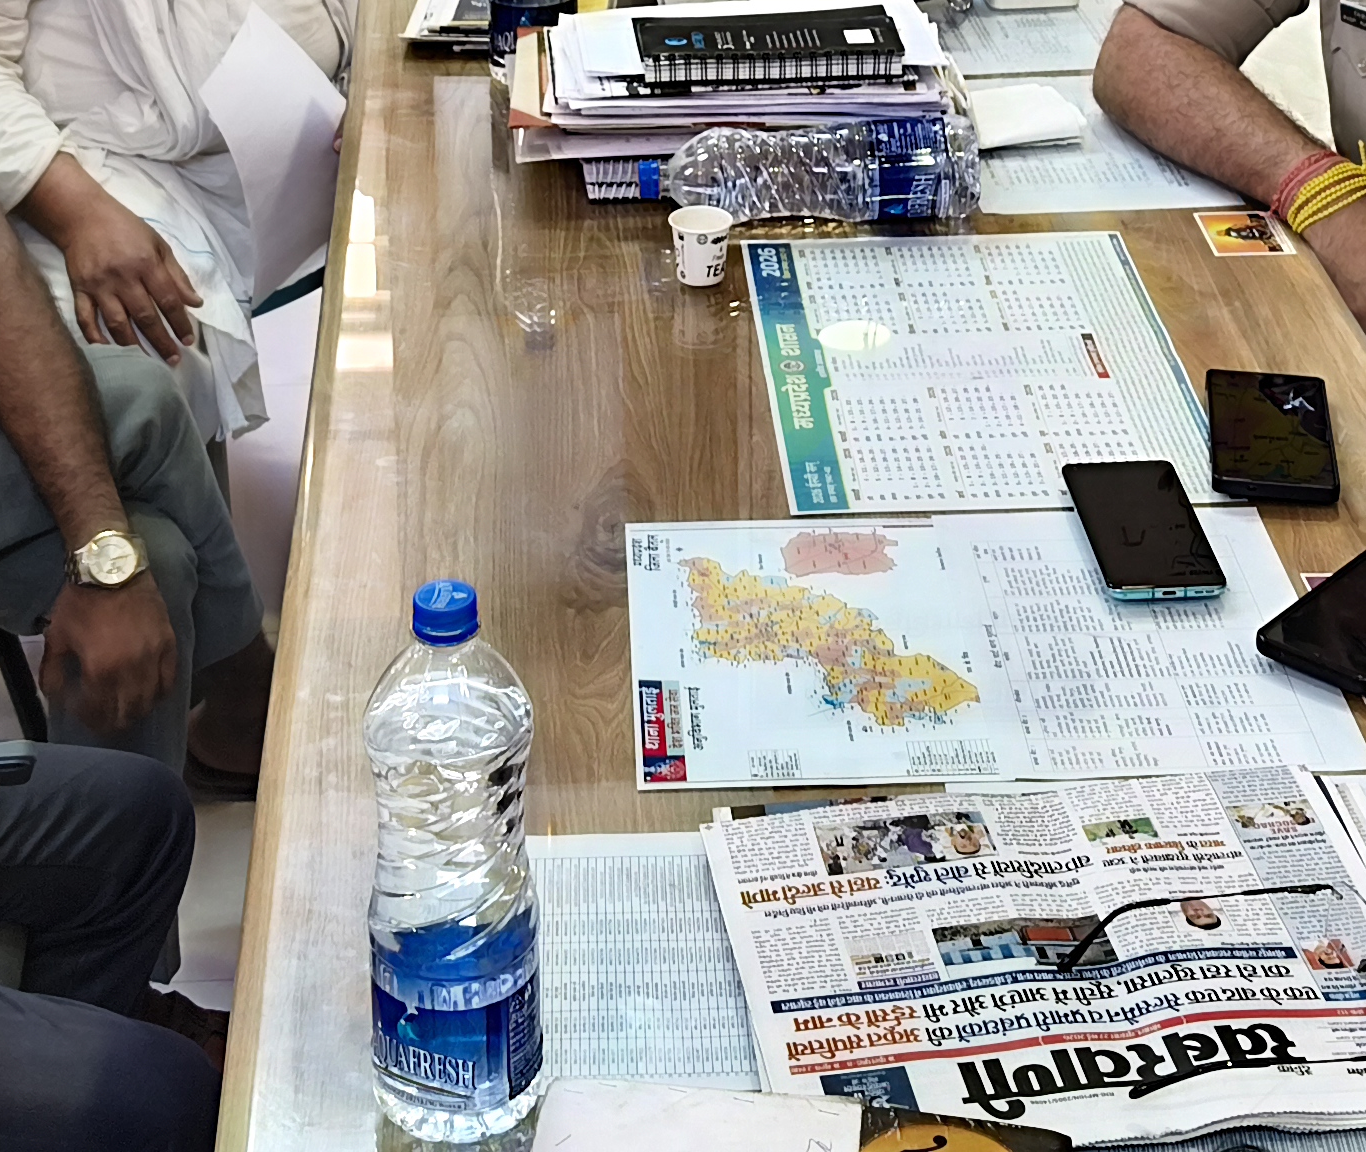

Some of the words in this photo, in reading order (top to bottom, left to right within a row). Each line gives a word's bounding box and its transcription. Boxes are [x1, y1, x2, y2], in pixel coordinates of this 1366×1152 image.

[758, 247, 781, 278] 2026
[776, 323, 801, 356] शासन
[781, 375, 815, 430] मध्यप्रदेश
[641, 687, 664, 722] मुलताई
[644, 723, 661, 750] थाना
[934, 865, 969, 884] बोले
[971, 862, 988, 877] से
[782, 881, 826, 905] जल्दी
[828, 881, 845, 899] से
[847, 875, 882, 894] यहां
[740, 888, 781, 909] भागो
[1116, 963, 1200, 994] खुलासा,
[1200, 963, 1236, 980] रहा
[1236, 963, 1261, 983] हो
[1260, 964, 1294, 979] का
[991, 986, 1047, 1016] आएंगे
[1052, 987, 1070, 1006] में
[1072, 979, 1115, 1007] सूची
[1184, 989, 1219, 1004] एक
[1220, 986, 1260, 1002] बाद
[1259, 986, 1284, 1006] के
[1283, 985, 1321, 1002] एक
[866, 1003, 918, 1027] रईसों
[949, 993, 987, 1018] और
[1104, 992, 1182, 1026] सेल्समैन
[792, 1014, 835, 1033] नाम
[837, 1011, 861, 1029] के
[921, 1004, 946, 1029] भी
[1031, 1007, 1089, 1034] प्रभारी
[1086, 1009, 1101, 1024] व
[867, 1024, 921, 1052] अकूत
[925, 1025, 953, 1046] की
[955, 1014, 1031, 1045] प्रबंधकों
[1277, 1063, 1313, 1076] दैनिक
